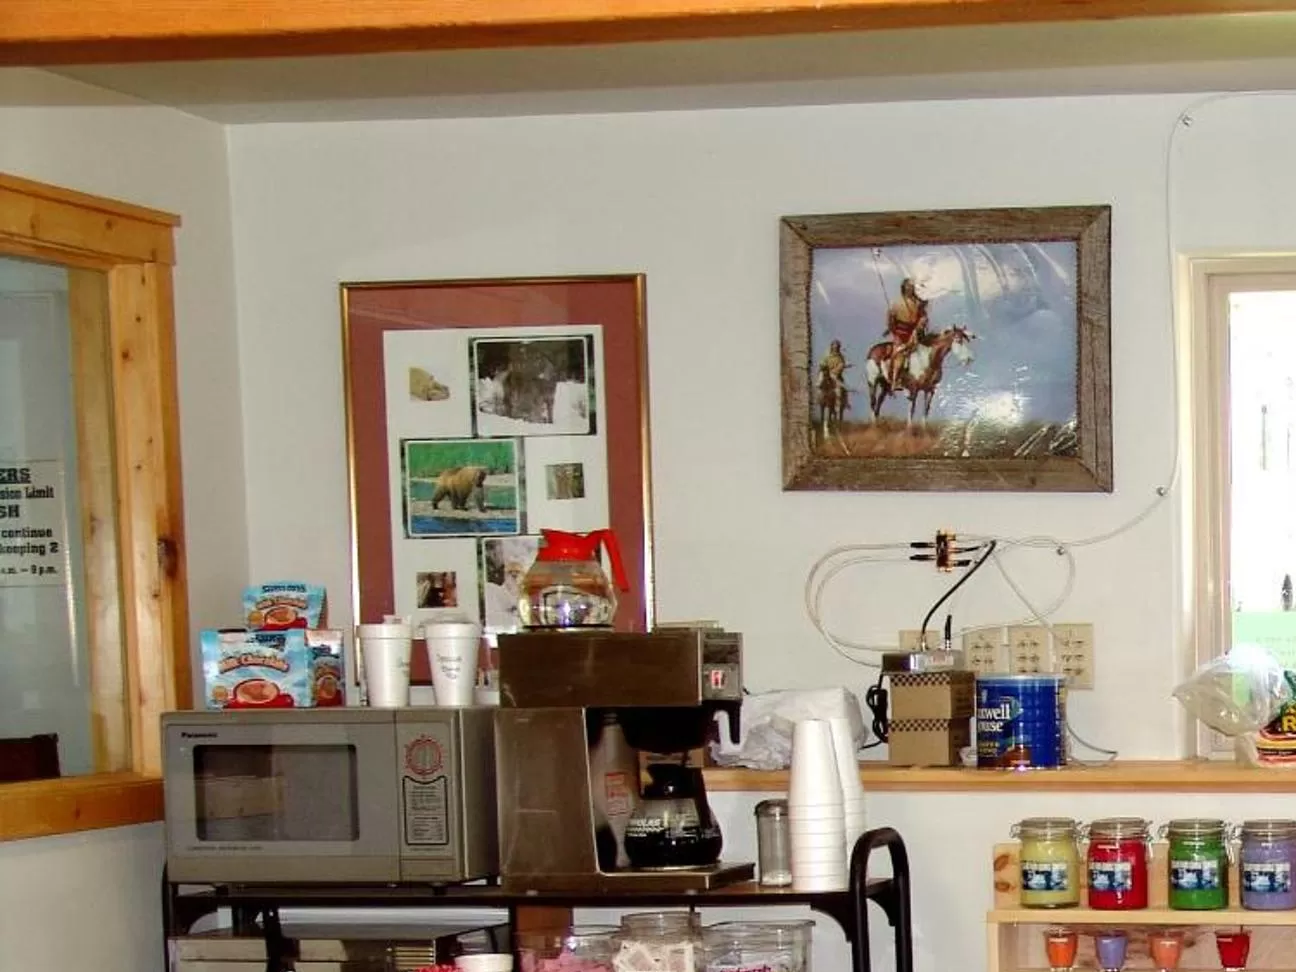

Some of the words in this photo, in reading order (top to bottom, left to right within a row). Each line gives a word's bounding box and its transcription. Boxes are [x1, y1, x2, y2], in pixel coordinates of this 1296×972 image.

[25, 485, 55, 499] Limit
[1, 528, 53, 538] continue
[49, 542, 59, 554] 2
